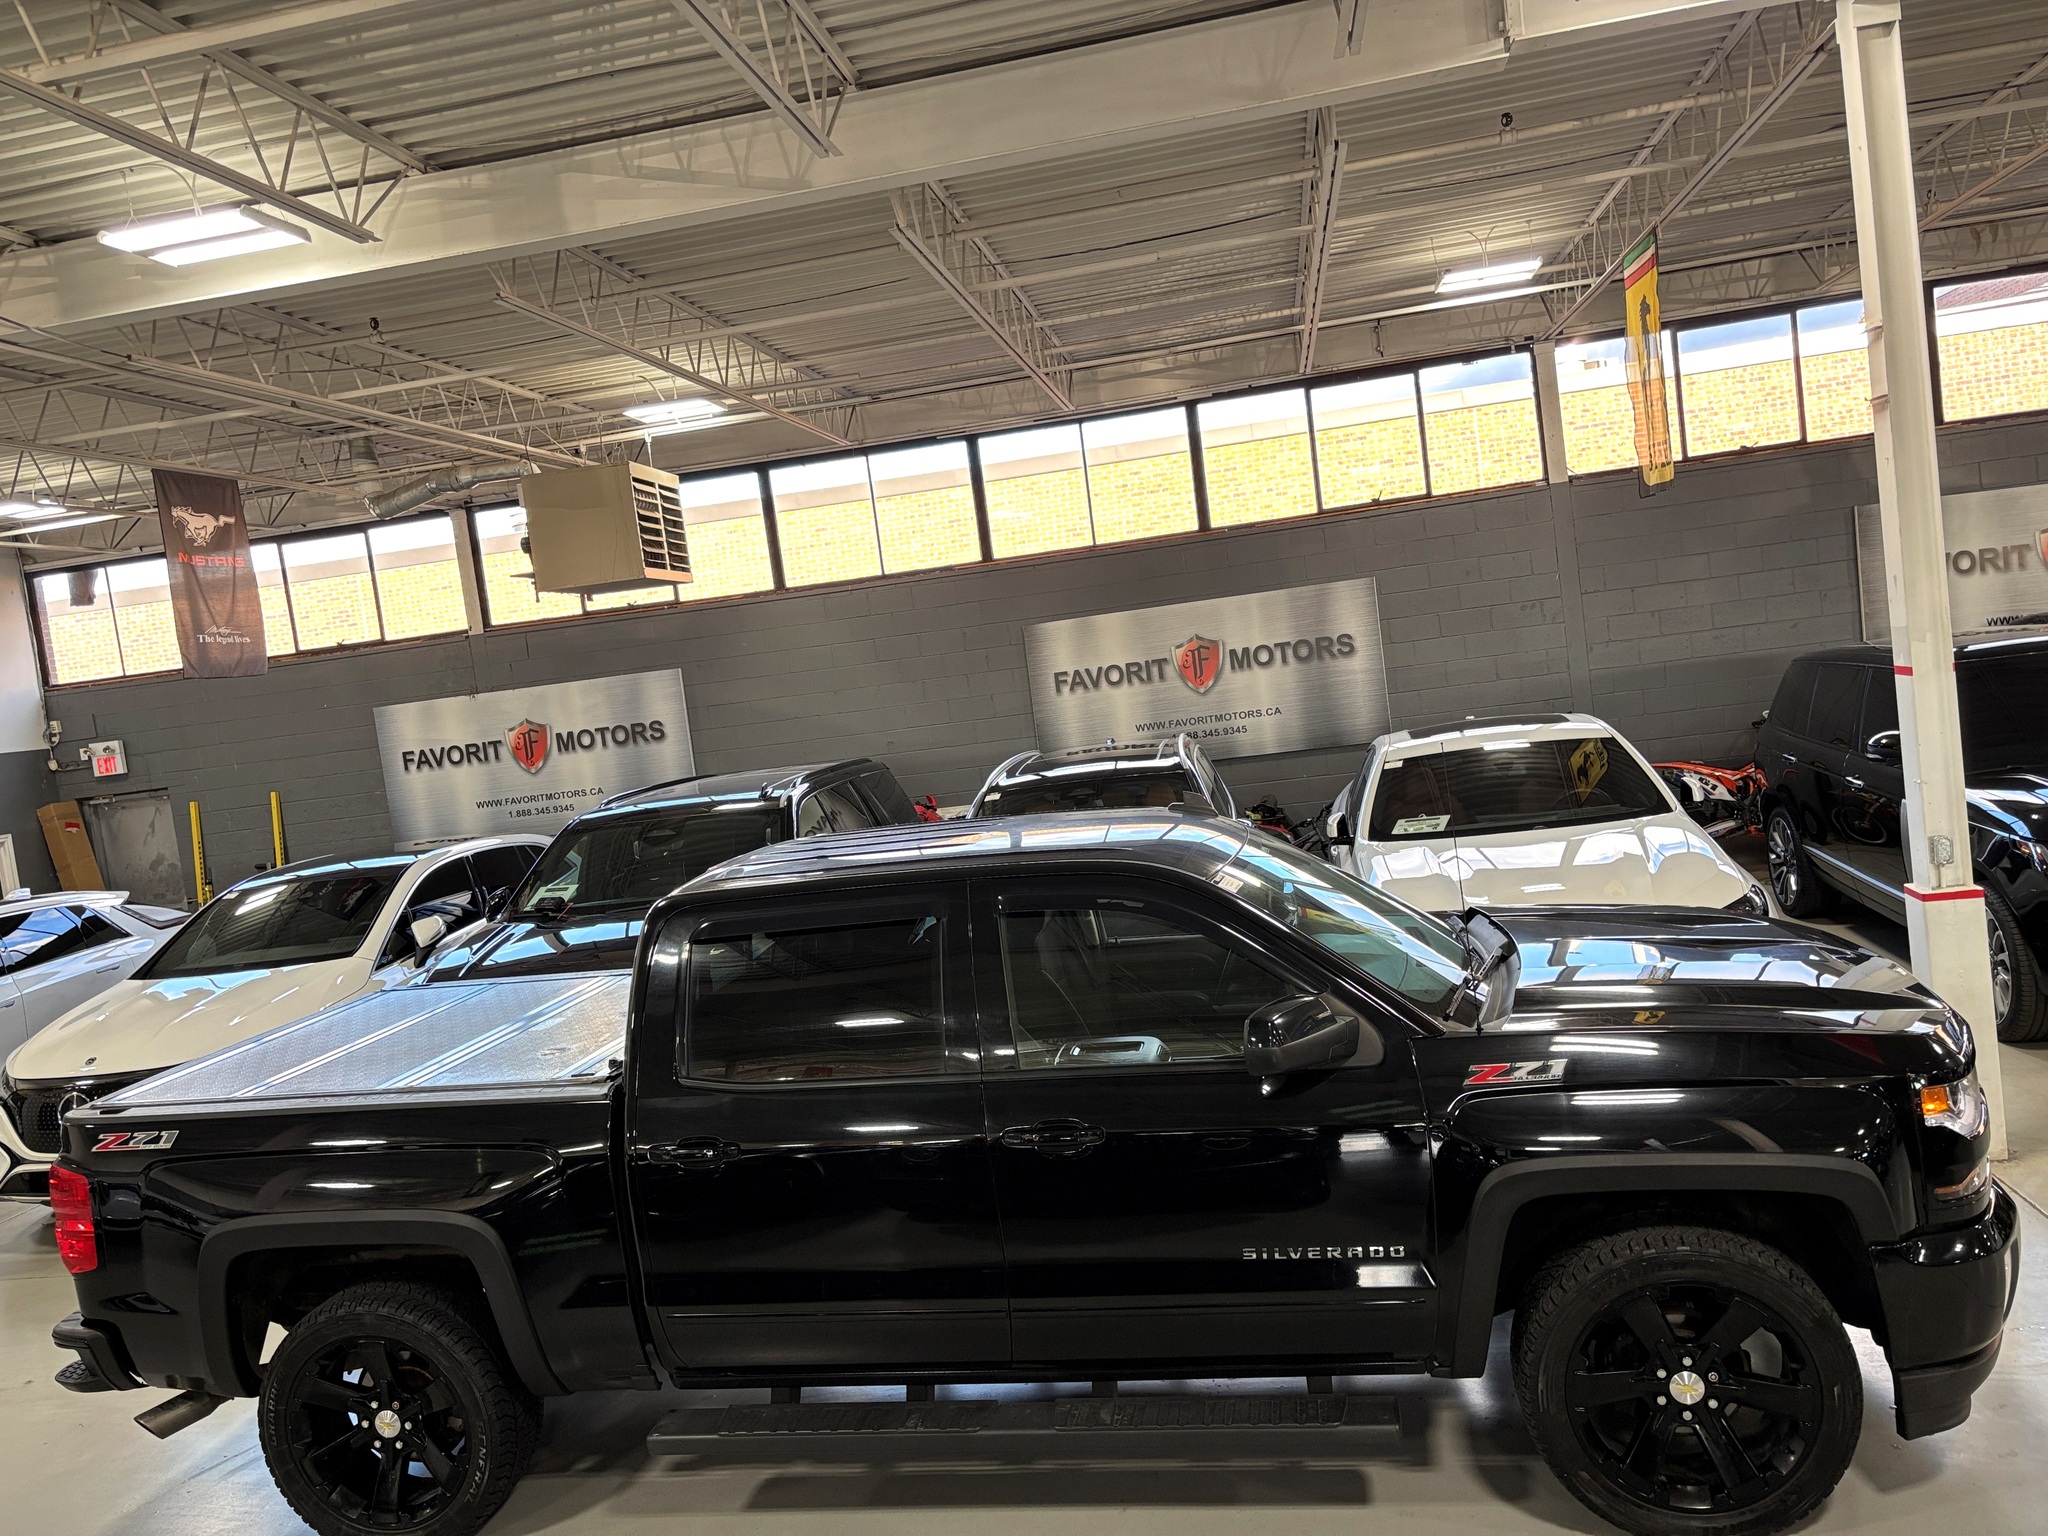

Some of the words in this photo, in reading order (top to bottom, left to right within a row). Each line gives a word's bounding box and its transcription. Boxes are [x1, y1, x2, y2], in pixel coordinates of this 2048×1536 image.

[178, 552, 244, 567] MUSTANG
[197, 634, 214, 643] The
[234, 635, 250, 643] lives
[1054, 657, 1168, 693] FAVORIT
[1229, 633, 1355, 671] MOTORS
[1135, 707, 1282, 732] WWW.FAVORITMOTORS.CA
[402, 740, 502, 771] FAVORIT
[556, 720, 665, 752] MOTORS
[97, 756, 117, 774] EXIT
[475, 787, 604, 809] WWW.FAVORITMOTORS.CA
[508, 804, 575, 819] 1.888.345.9345
[1463, 1059, 1568, 1085] Z71
[91, 1130, 179, 1152] Z71
[1242, 1246, 1405, 1260] SILVERADO
